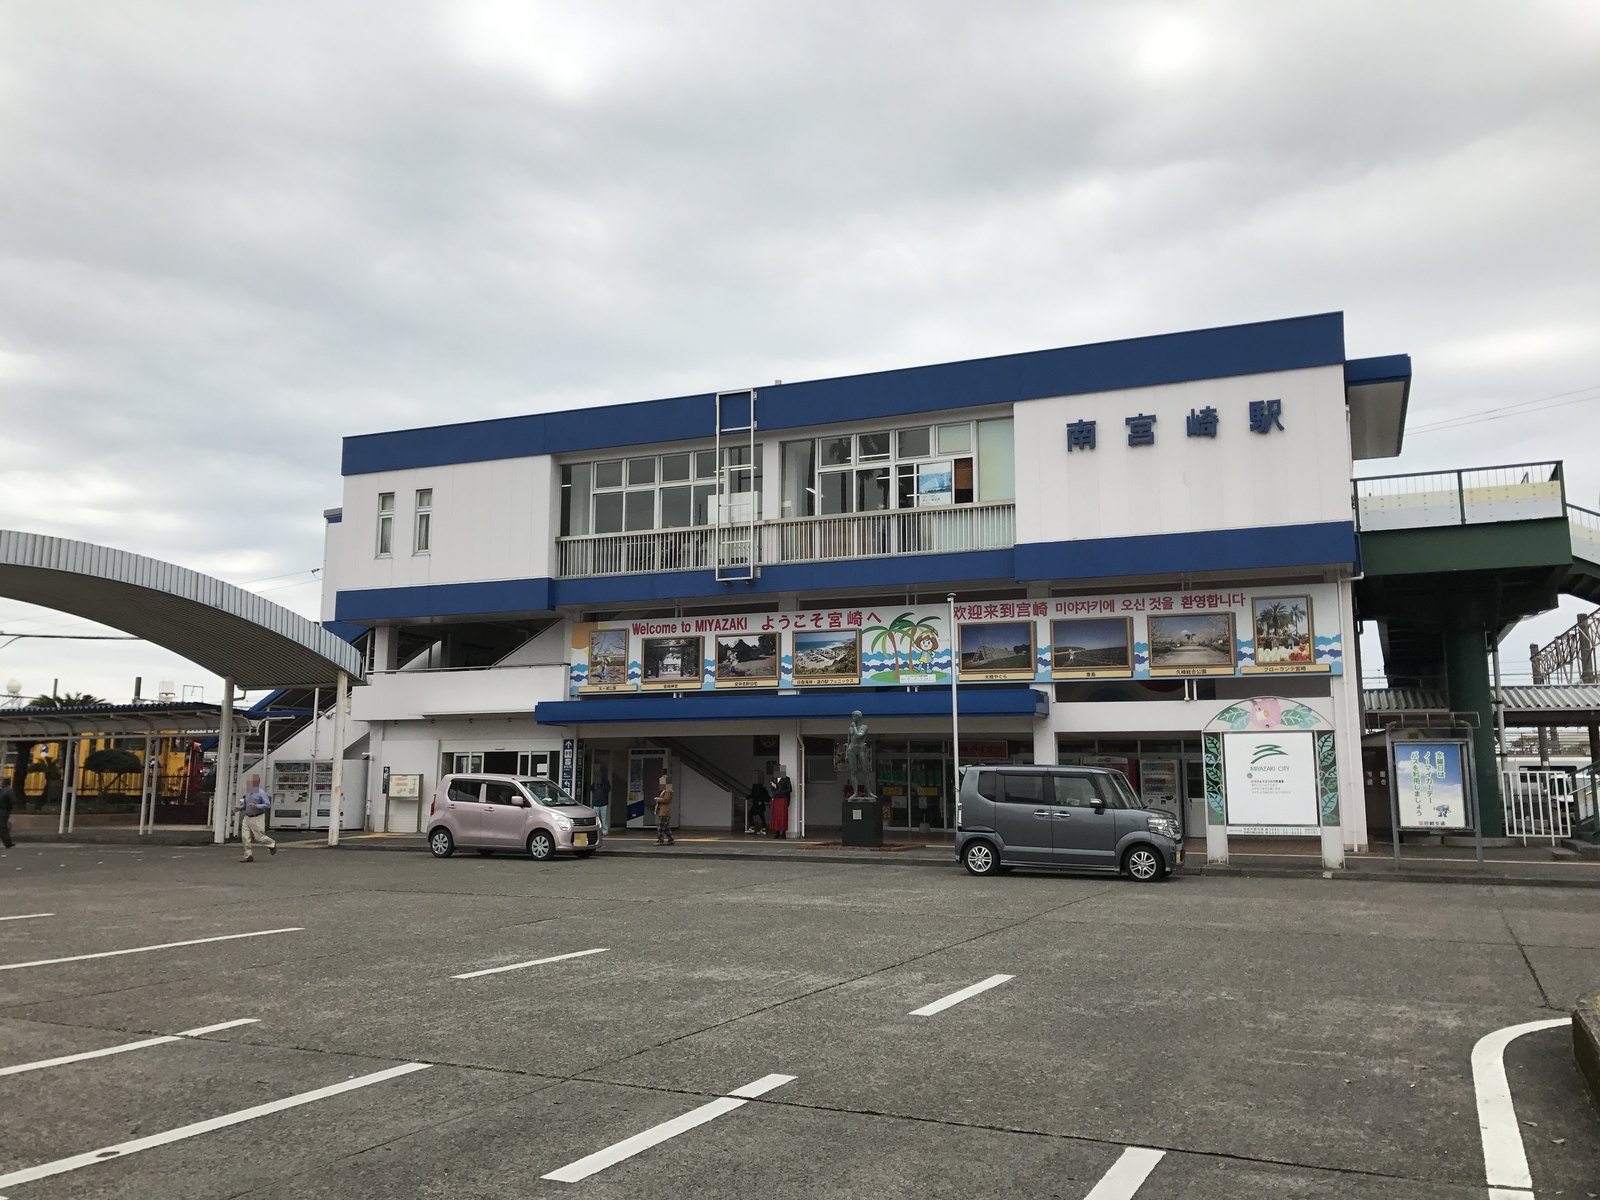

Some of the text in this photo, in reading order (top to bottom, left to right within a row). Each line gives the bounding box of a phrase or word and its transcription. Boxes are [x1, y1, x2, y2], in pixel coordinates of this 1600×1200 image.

[1066, 399, 1285, 452] 南宮崎駅
[1055, 592, 1246, 615] 미야자키에 오신 것을 환영합니다
[632, 617, 748, 635] Welcome to MIYAZAKI
[761, 610, 883, 631] ようこそ宮崎へ
[1435, 751, 1445, 778] 水曜日は
